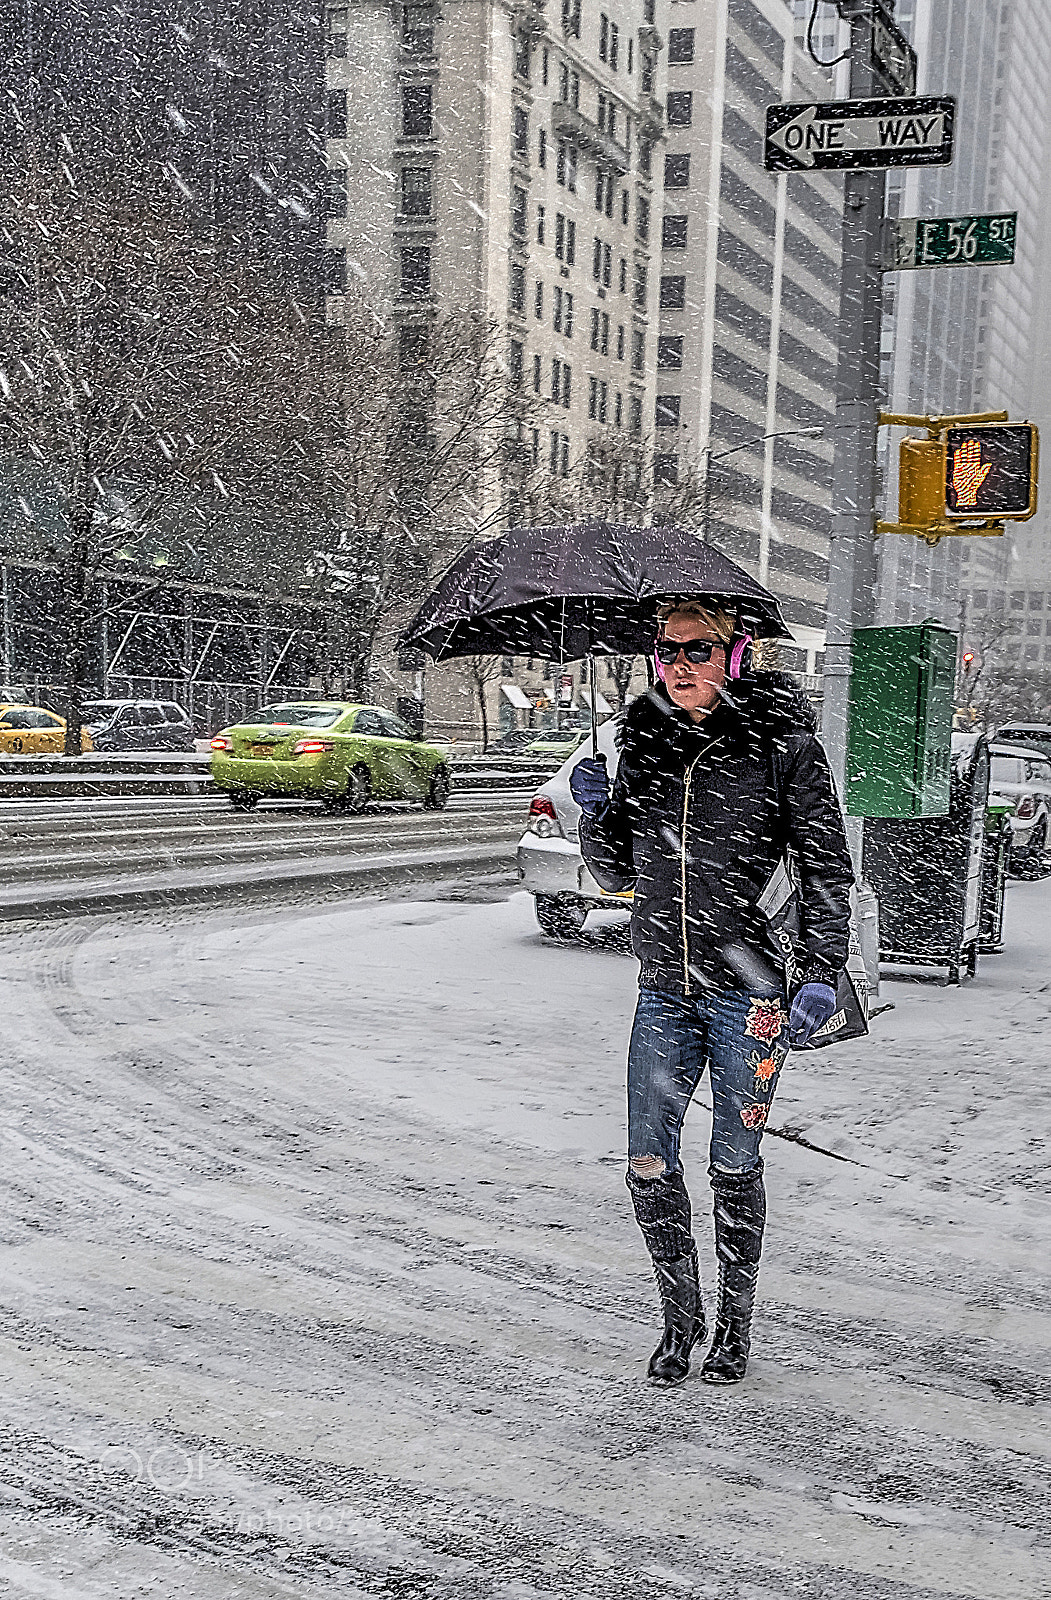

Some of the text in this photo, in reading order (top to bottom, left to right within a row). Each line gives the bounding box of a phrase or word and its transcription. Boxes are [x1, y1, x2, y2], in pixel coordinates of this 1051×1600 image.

[785, 117, 939, 151] ONE WAY
[922, 222, 942, 261] E
[946, 220, 979, 260] 56
